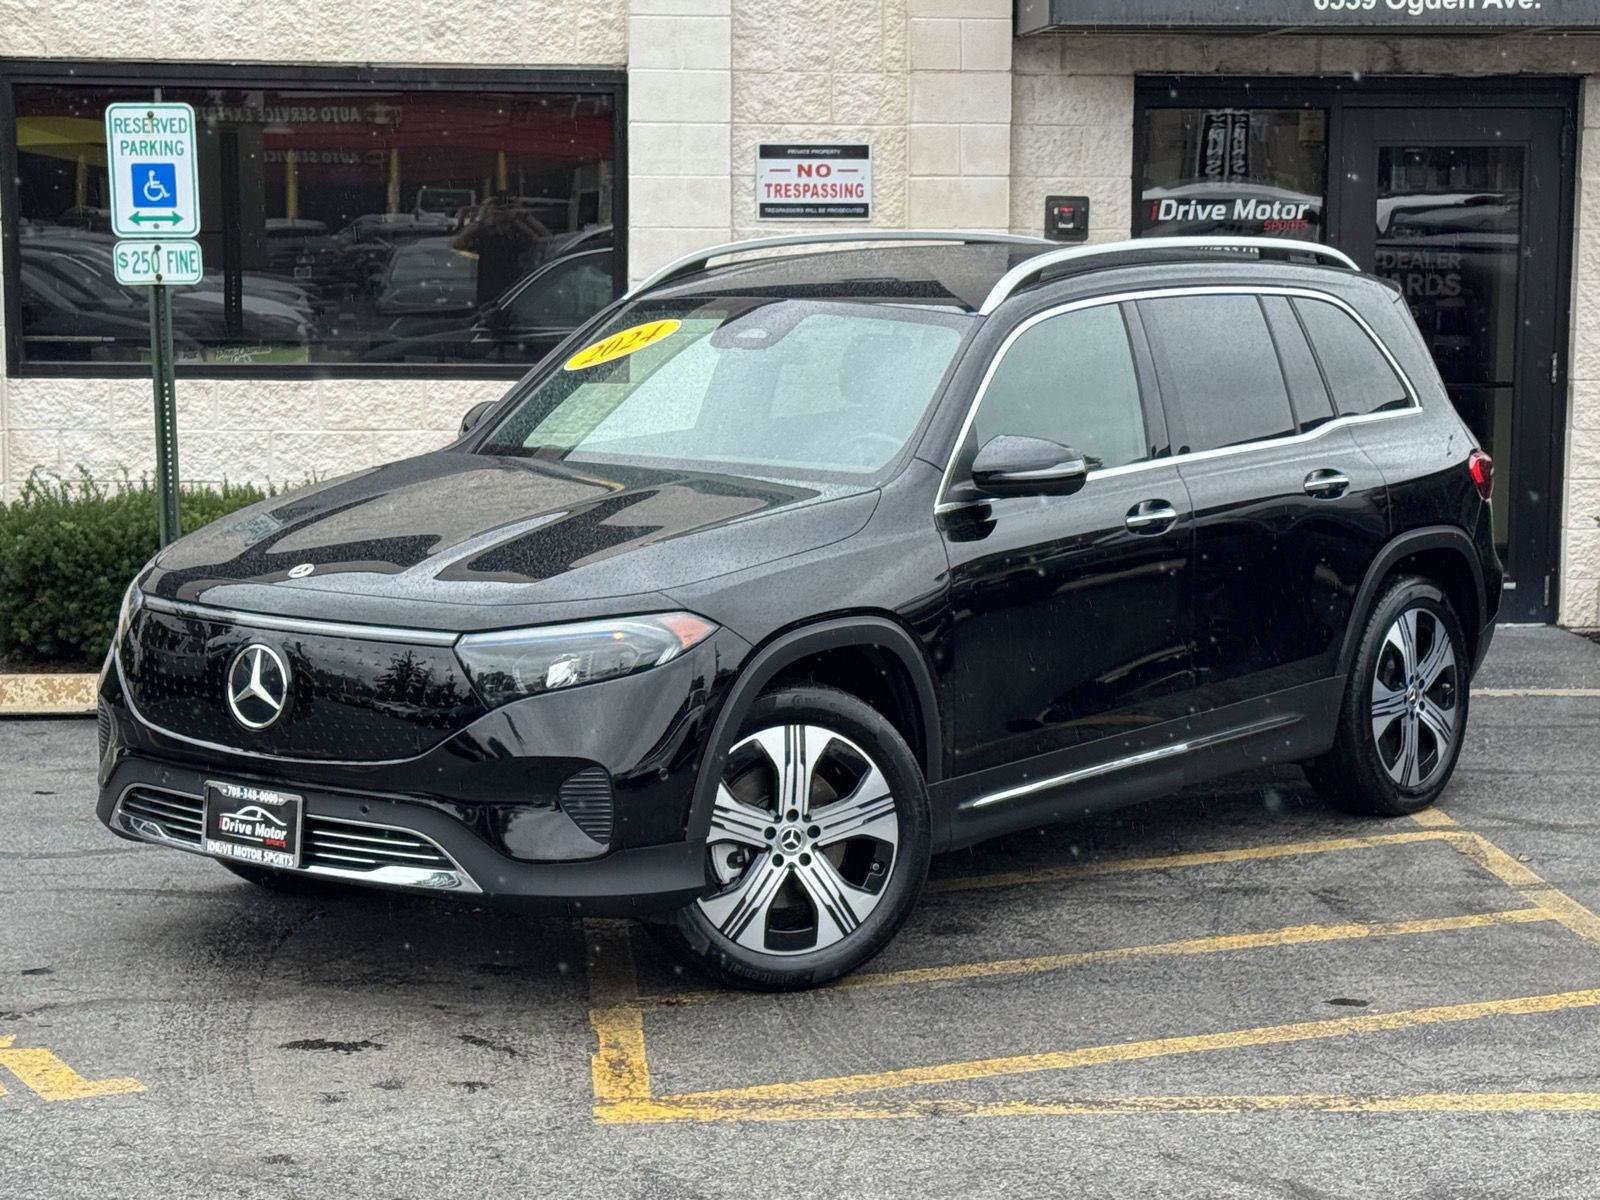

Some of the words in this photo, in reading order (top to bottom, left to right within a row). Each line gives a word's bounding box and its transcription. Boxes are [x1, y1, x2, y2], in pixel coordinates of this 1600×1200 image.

[114, 117, 187, 134] RESERVED
[120, 140, 184, 156] PARKING
[797, 164, 831, 178] NO
[764, 183, 864, 199] TRESPASSING
[1151, 200, 1226, 220] iDrive
[1232, 199, 1309, 220] Motor
[118, 250, 161, 274] $250
[167, 250, 198, 274] FINE
[1382, 251, 1462, 270] DEALER
[1391, 273, 1462, 296] RDS
[579, 322, 667, 366] 2024
[255, 823, 287, 840] Motor
[234, 845, 262, 860] MOTOR
[264, 851, 294, 867] SPORTS
